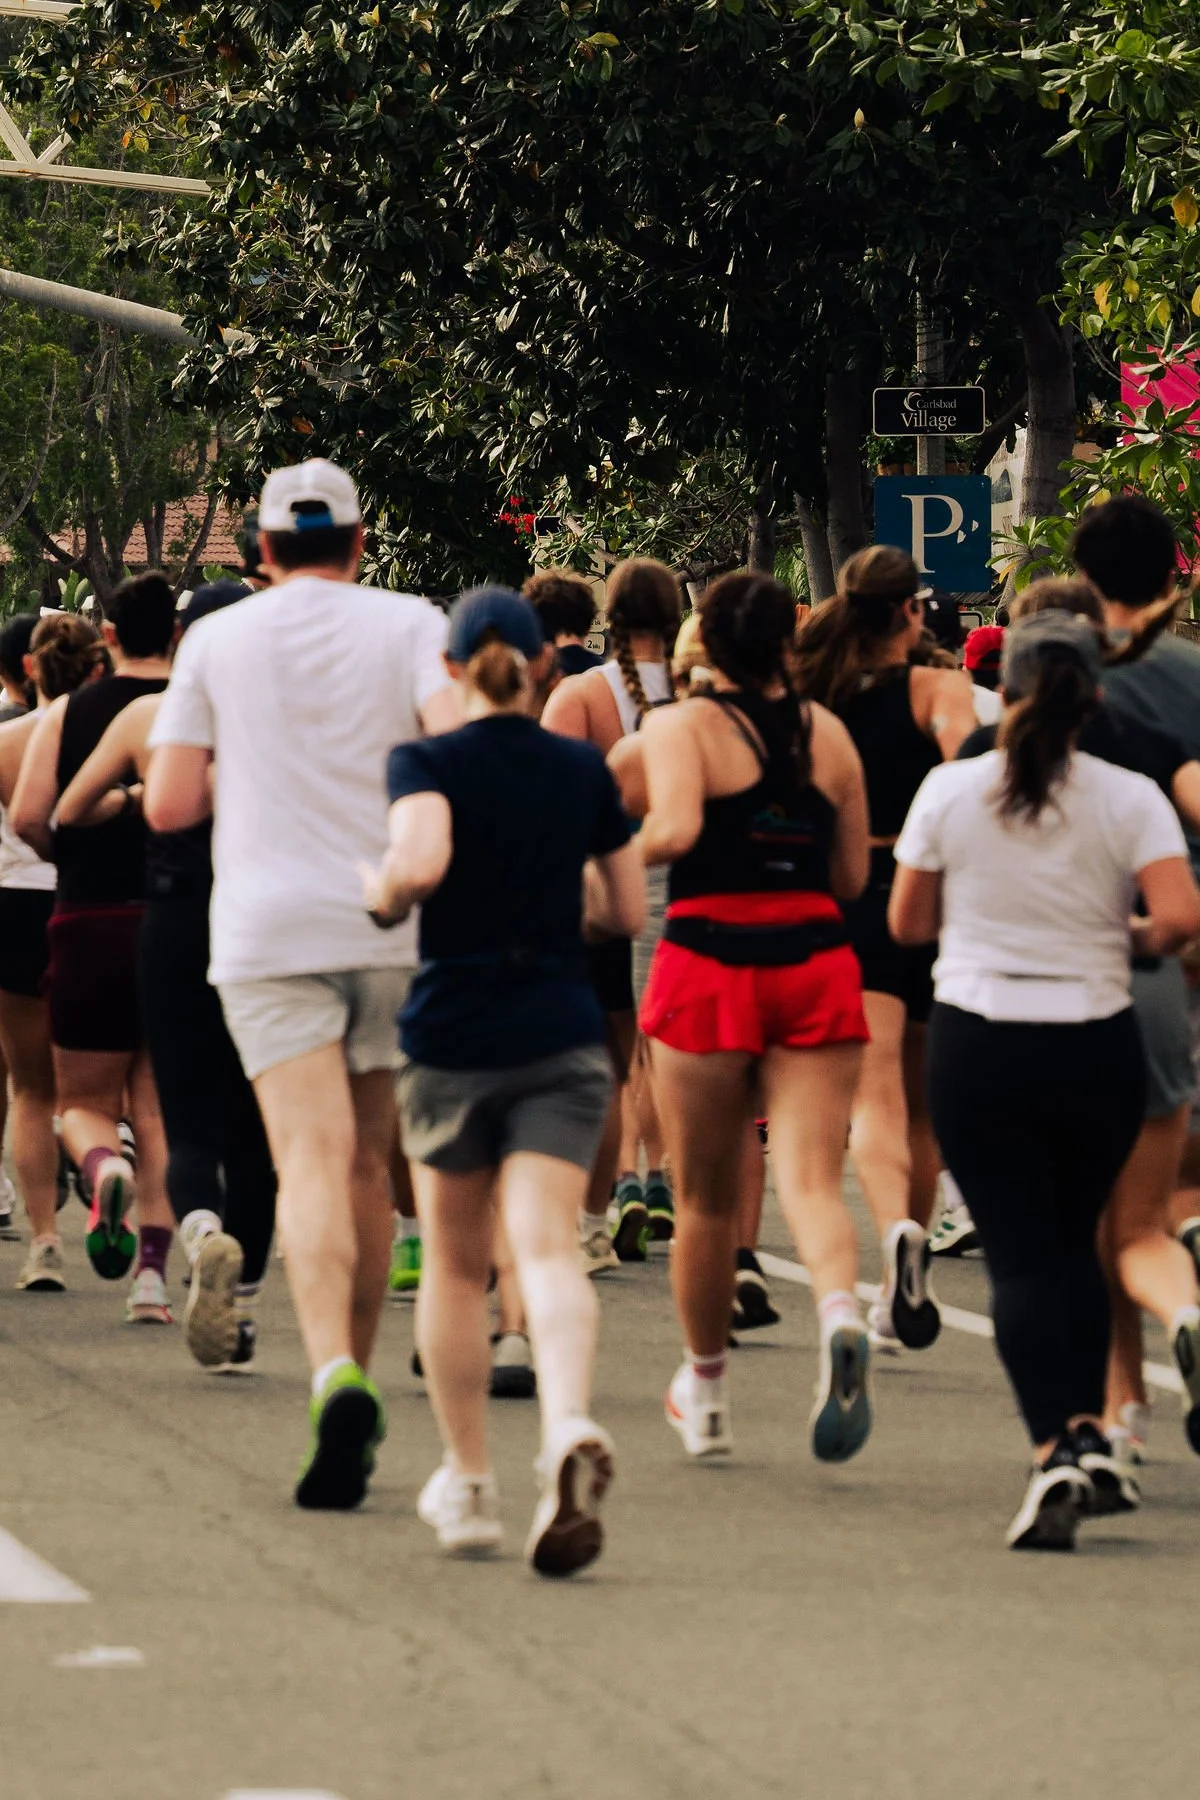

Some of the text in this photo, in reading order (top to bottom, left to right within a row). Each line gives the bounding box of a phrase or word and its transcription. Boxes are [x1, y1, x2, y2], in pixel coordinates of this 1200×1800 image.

[916, 399, 957, 409] Carlsbad
[901, 410, 957, 431] Village
[901, 494, 964, 573] P
